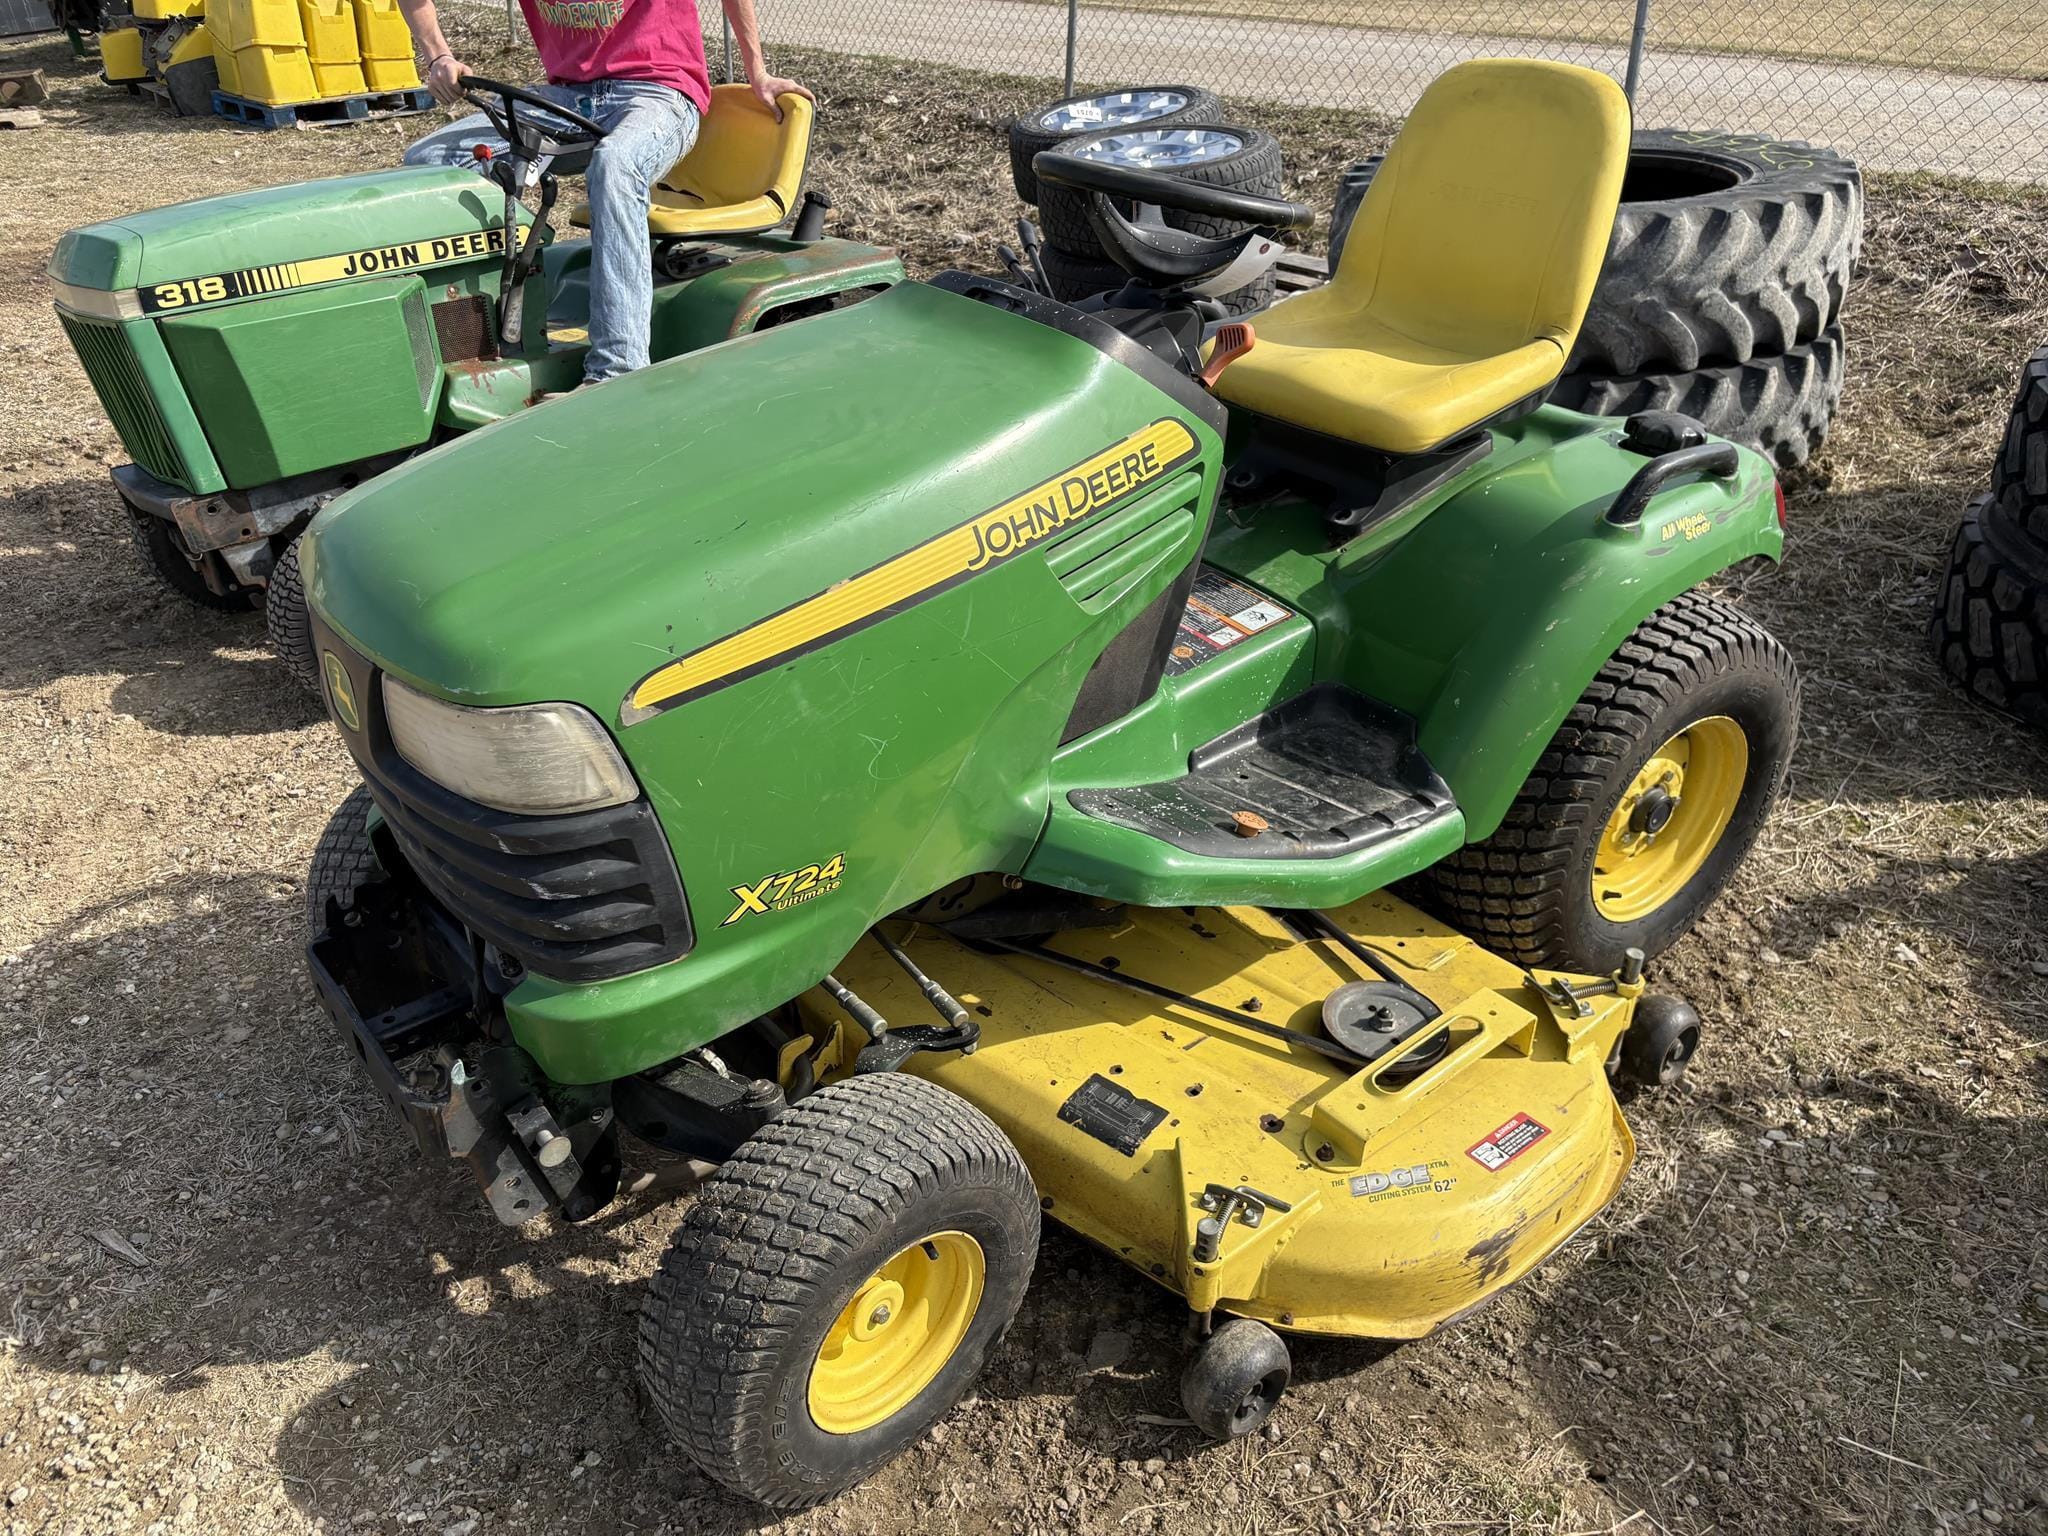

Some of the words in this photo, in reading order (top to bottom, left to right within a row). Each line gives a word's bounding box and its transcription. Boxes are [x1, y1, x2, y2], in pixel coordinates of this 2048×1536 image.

[343, 244, 421, 276] JOHN
[154, 275, 228, 310] 318
[967, 495, 1060, 568] JOHN
[1061, 442, 1161, 516] DEERE
[1661, 523, 1676, 541] All
[1676, 509, 1707, 531] Wheel
[1684, 521, 1711, 541] Steer
[718, 853, 846, 928] X724
[777, 880, 841, 911] Ultimate
[1331, 1178, 1345, 1188] THE
[1349, 1164, 1431, 1197] EDGE
[1368, 1191, 1400, 1203] CUTTING
[1401, 1184, 1432, 1197] SYSTEM
[1433, 1178, 1458, 1193] 62"
